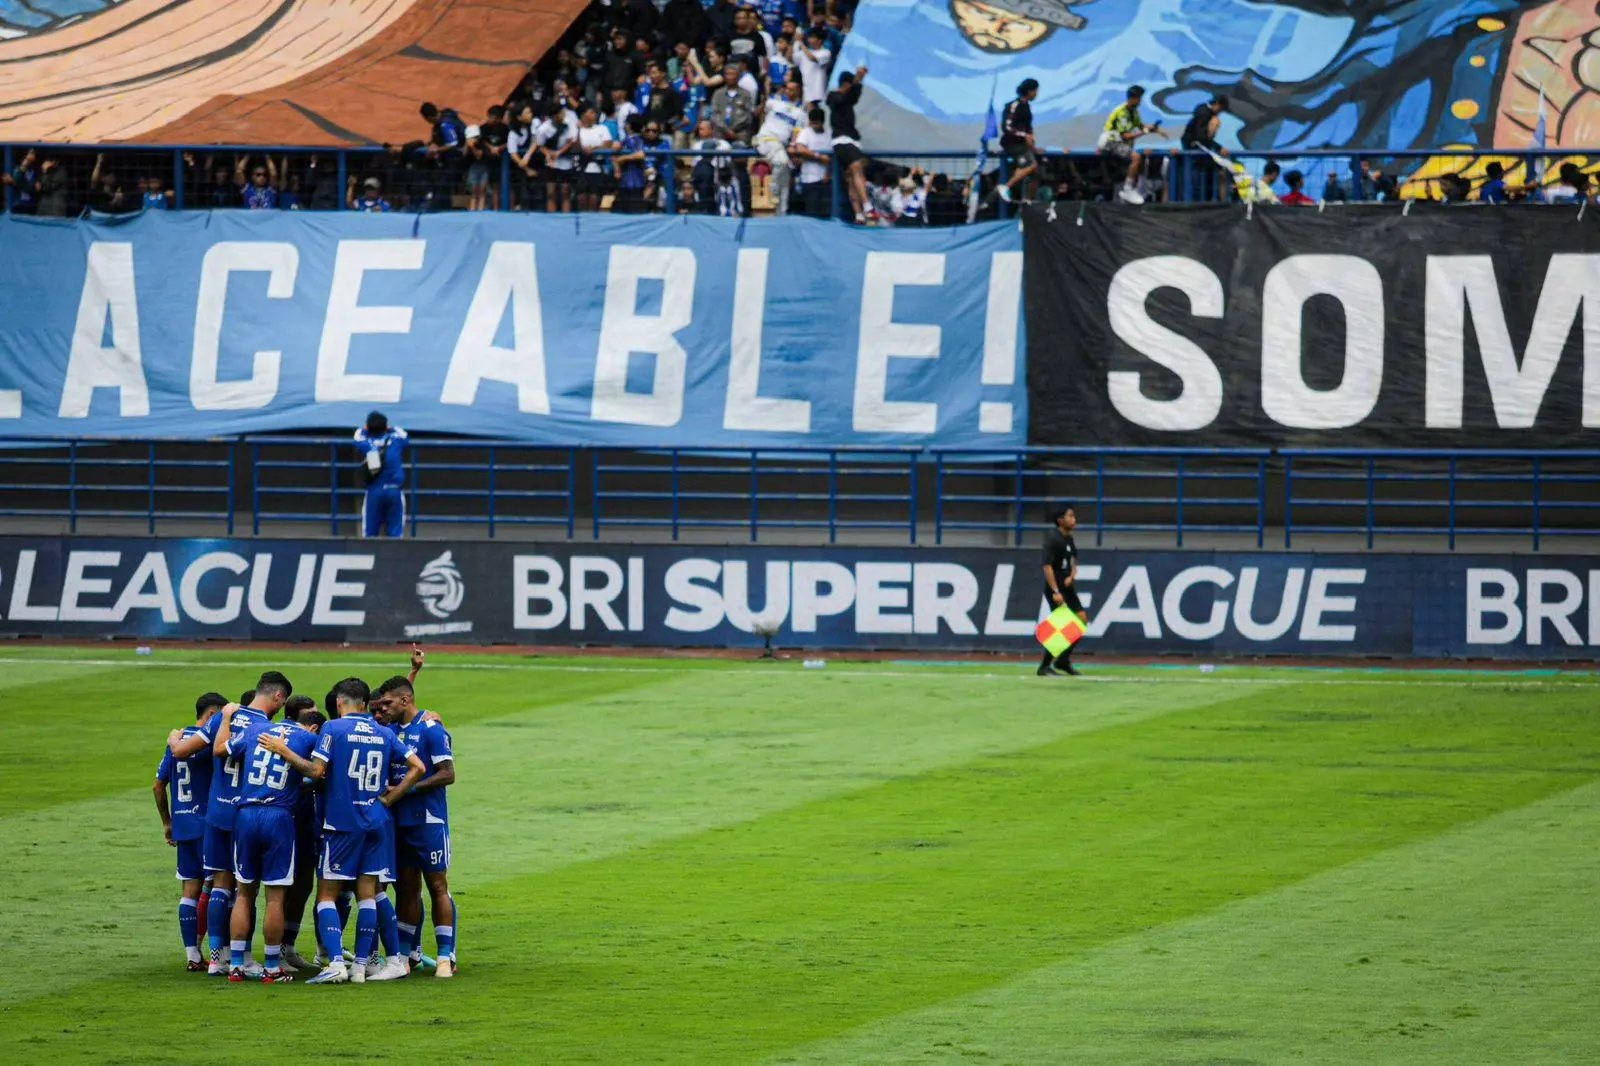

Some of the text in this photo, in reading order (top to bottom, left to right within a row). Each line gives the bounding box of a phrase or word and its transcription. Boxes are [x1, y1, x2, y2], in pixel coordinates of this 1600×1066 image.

[0, 239, 1022, 434] ACEABLE!
[1107, 253, 1600, 431] SOM
[8, 550, 376, 626] LEAGUE
[512, 555, 645, 632] BRI
[663, 558, 979, 637] SUPER
[1466, 568, 1600, 646] BRI
[354, 725, 375, 734] ABC
[176, 761, 193, 803] 2
[223, 756, 241, 788] 4
[248, 743, 292, 790] 33
[347, 749, 384, 792] 48
[430, 849, 444, 865] 97
